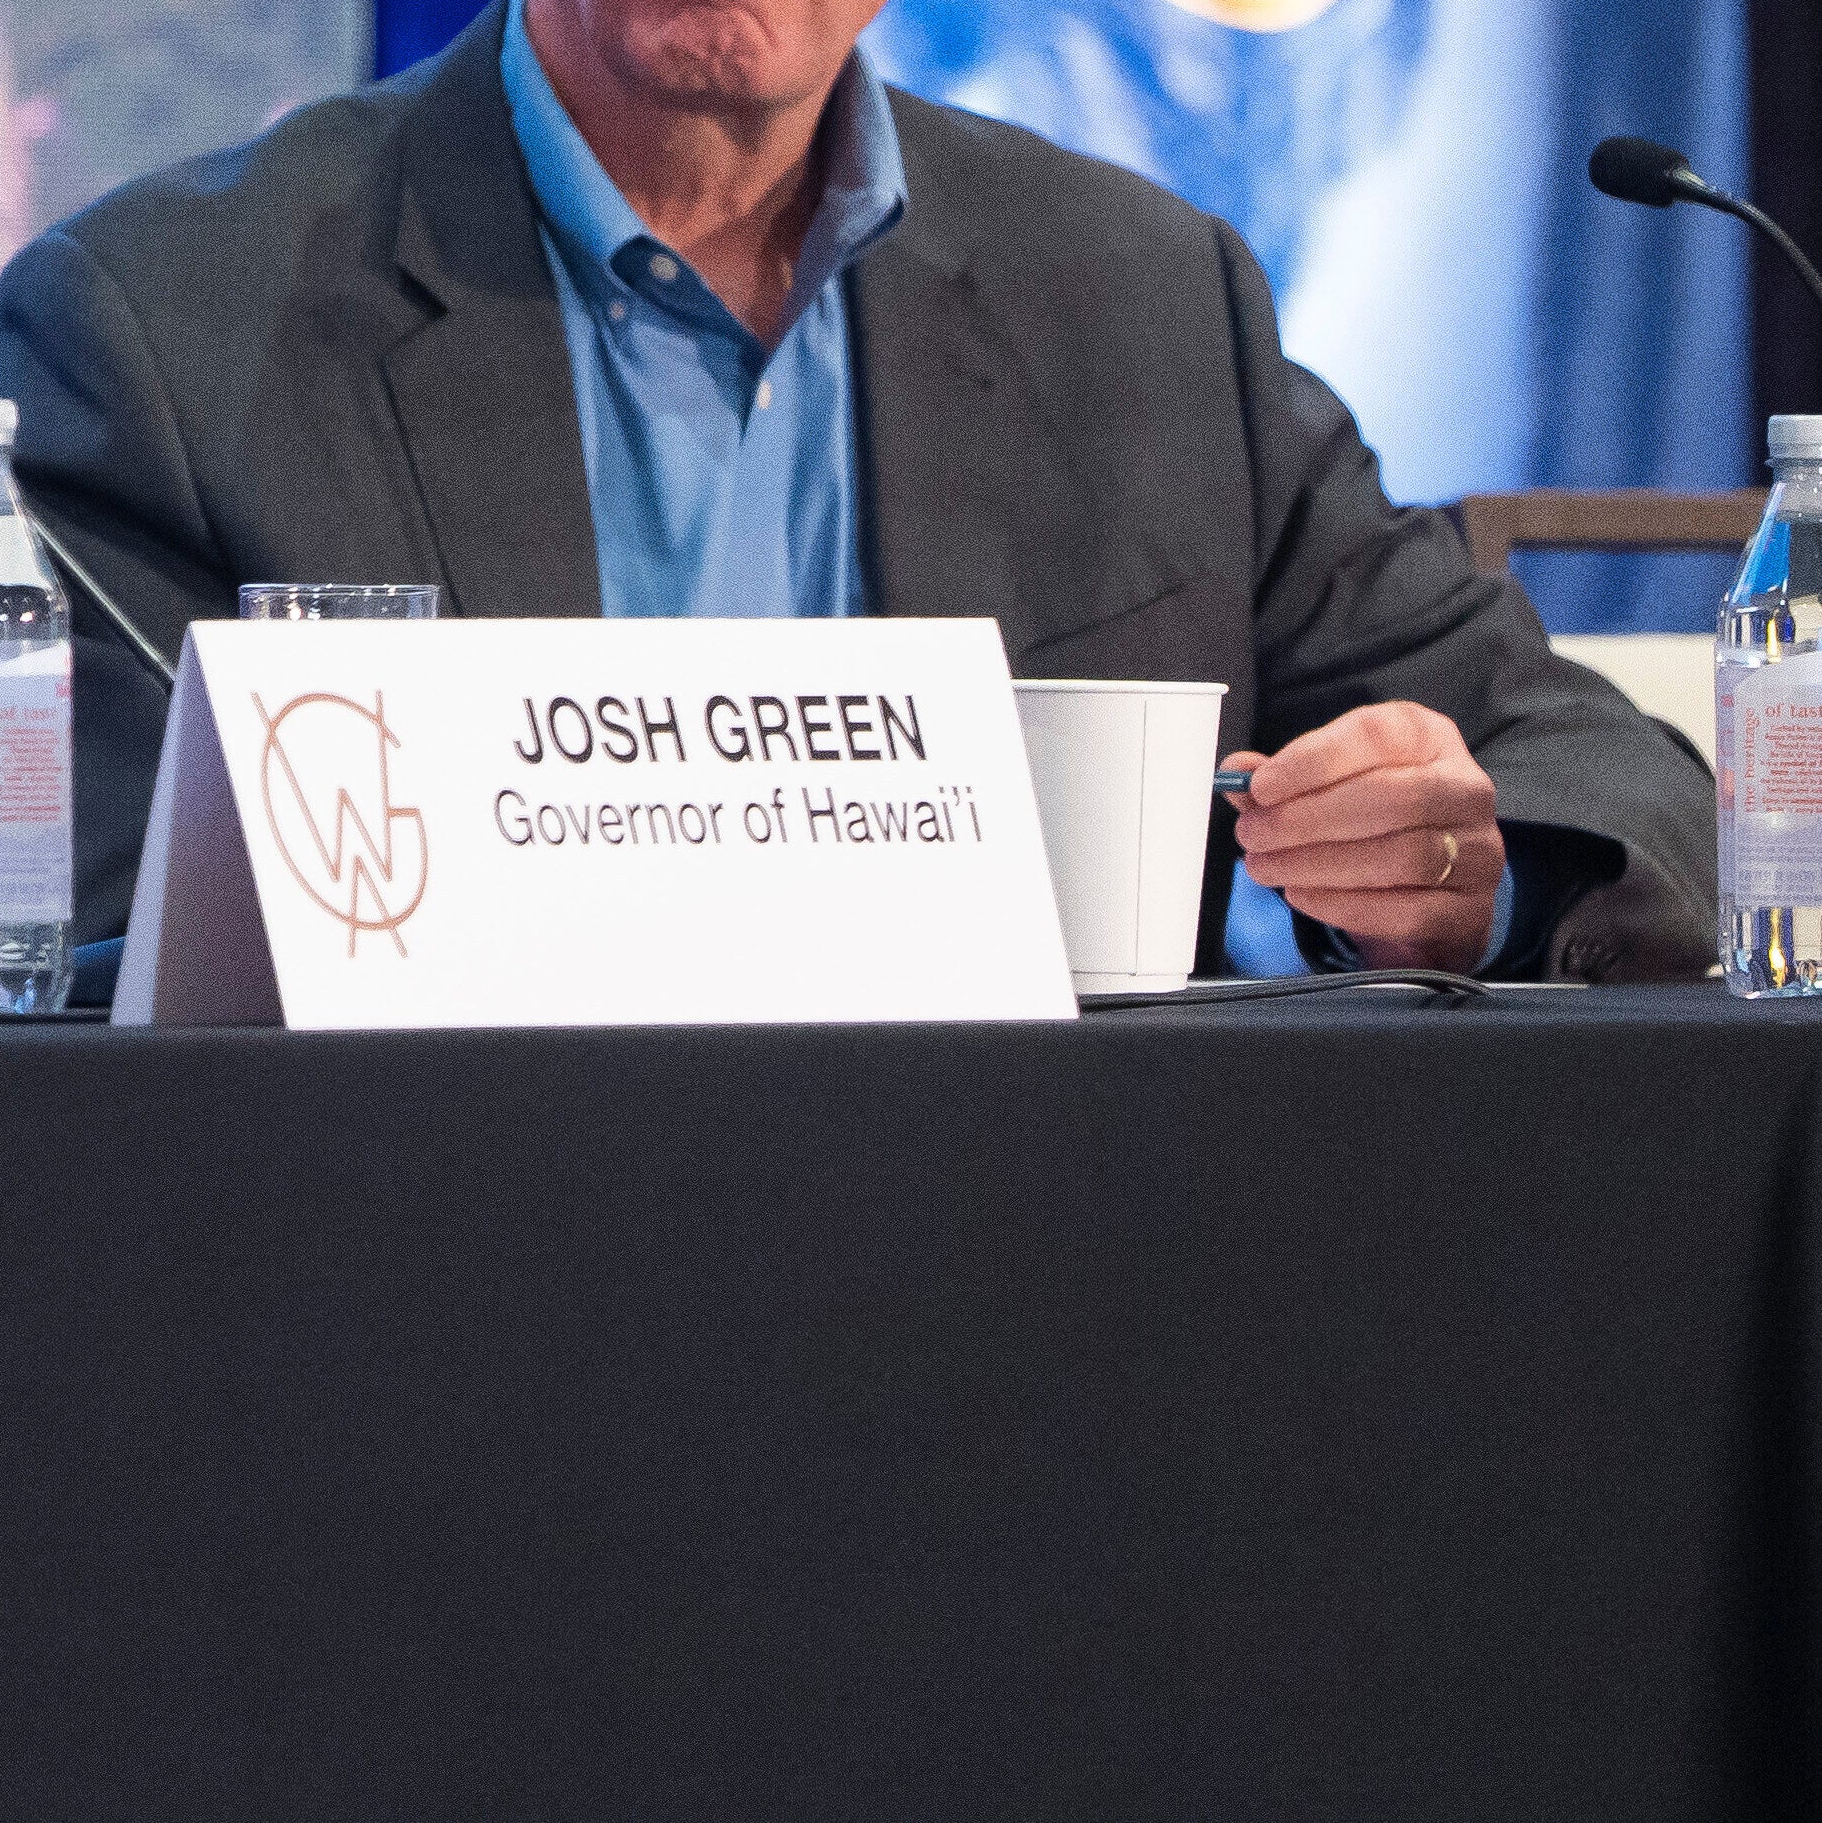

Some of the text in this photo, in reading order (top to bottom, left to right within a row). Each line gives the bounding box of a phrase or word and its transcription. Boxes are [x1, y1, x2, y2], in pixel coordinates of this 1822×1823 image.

[512, 692, 929, 766] JOSH GREEN
[492, 785, 983, 848] Governor of Hawai'i
